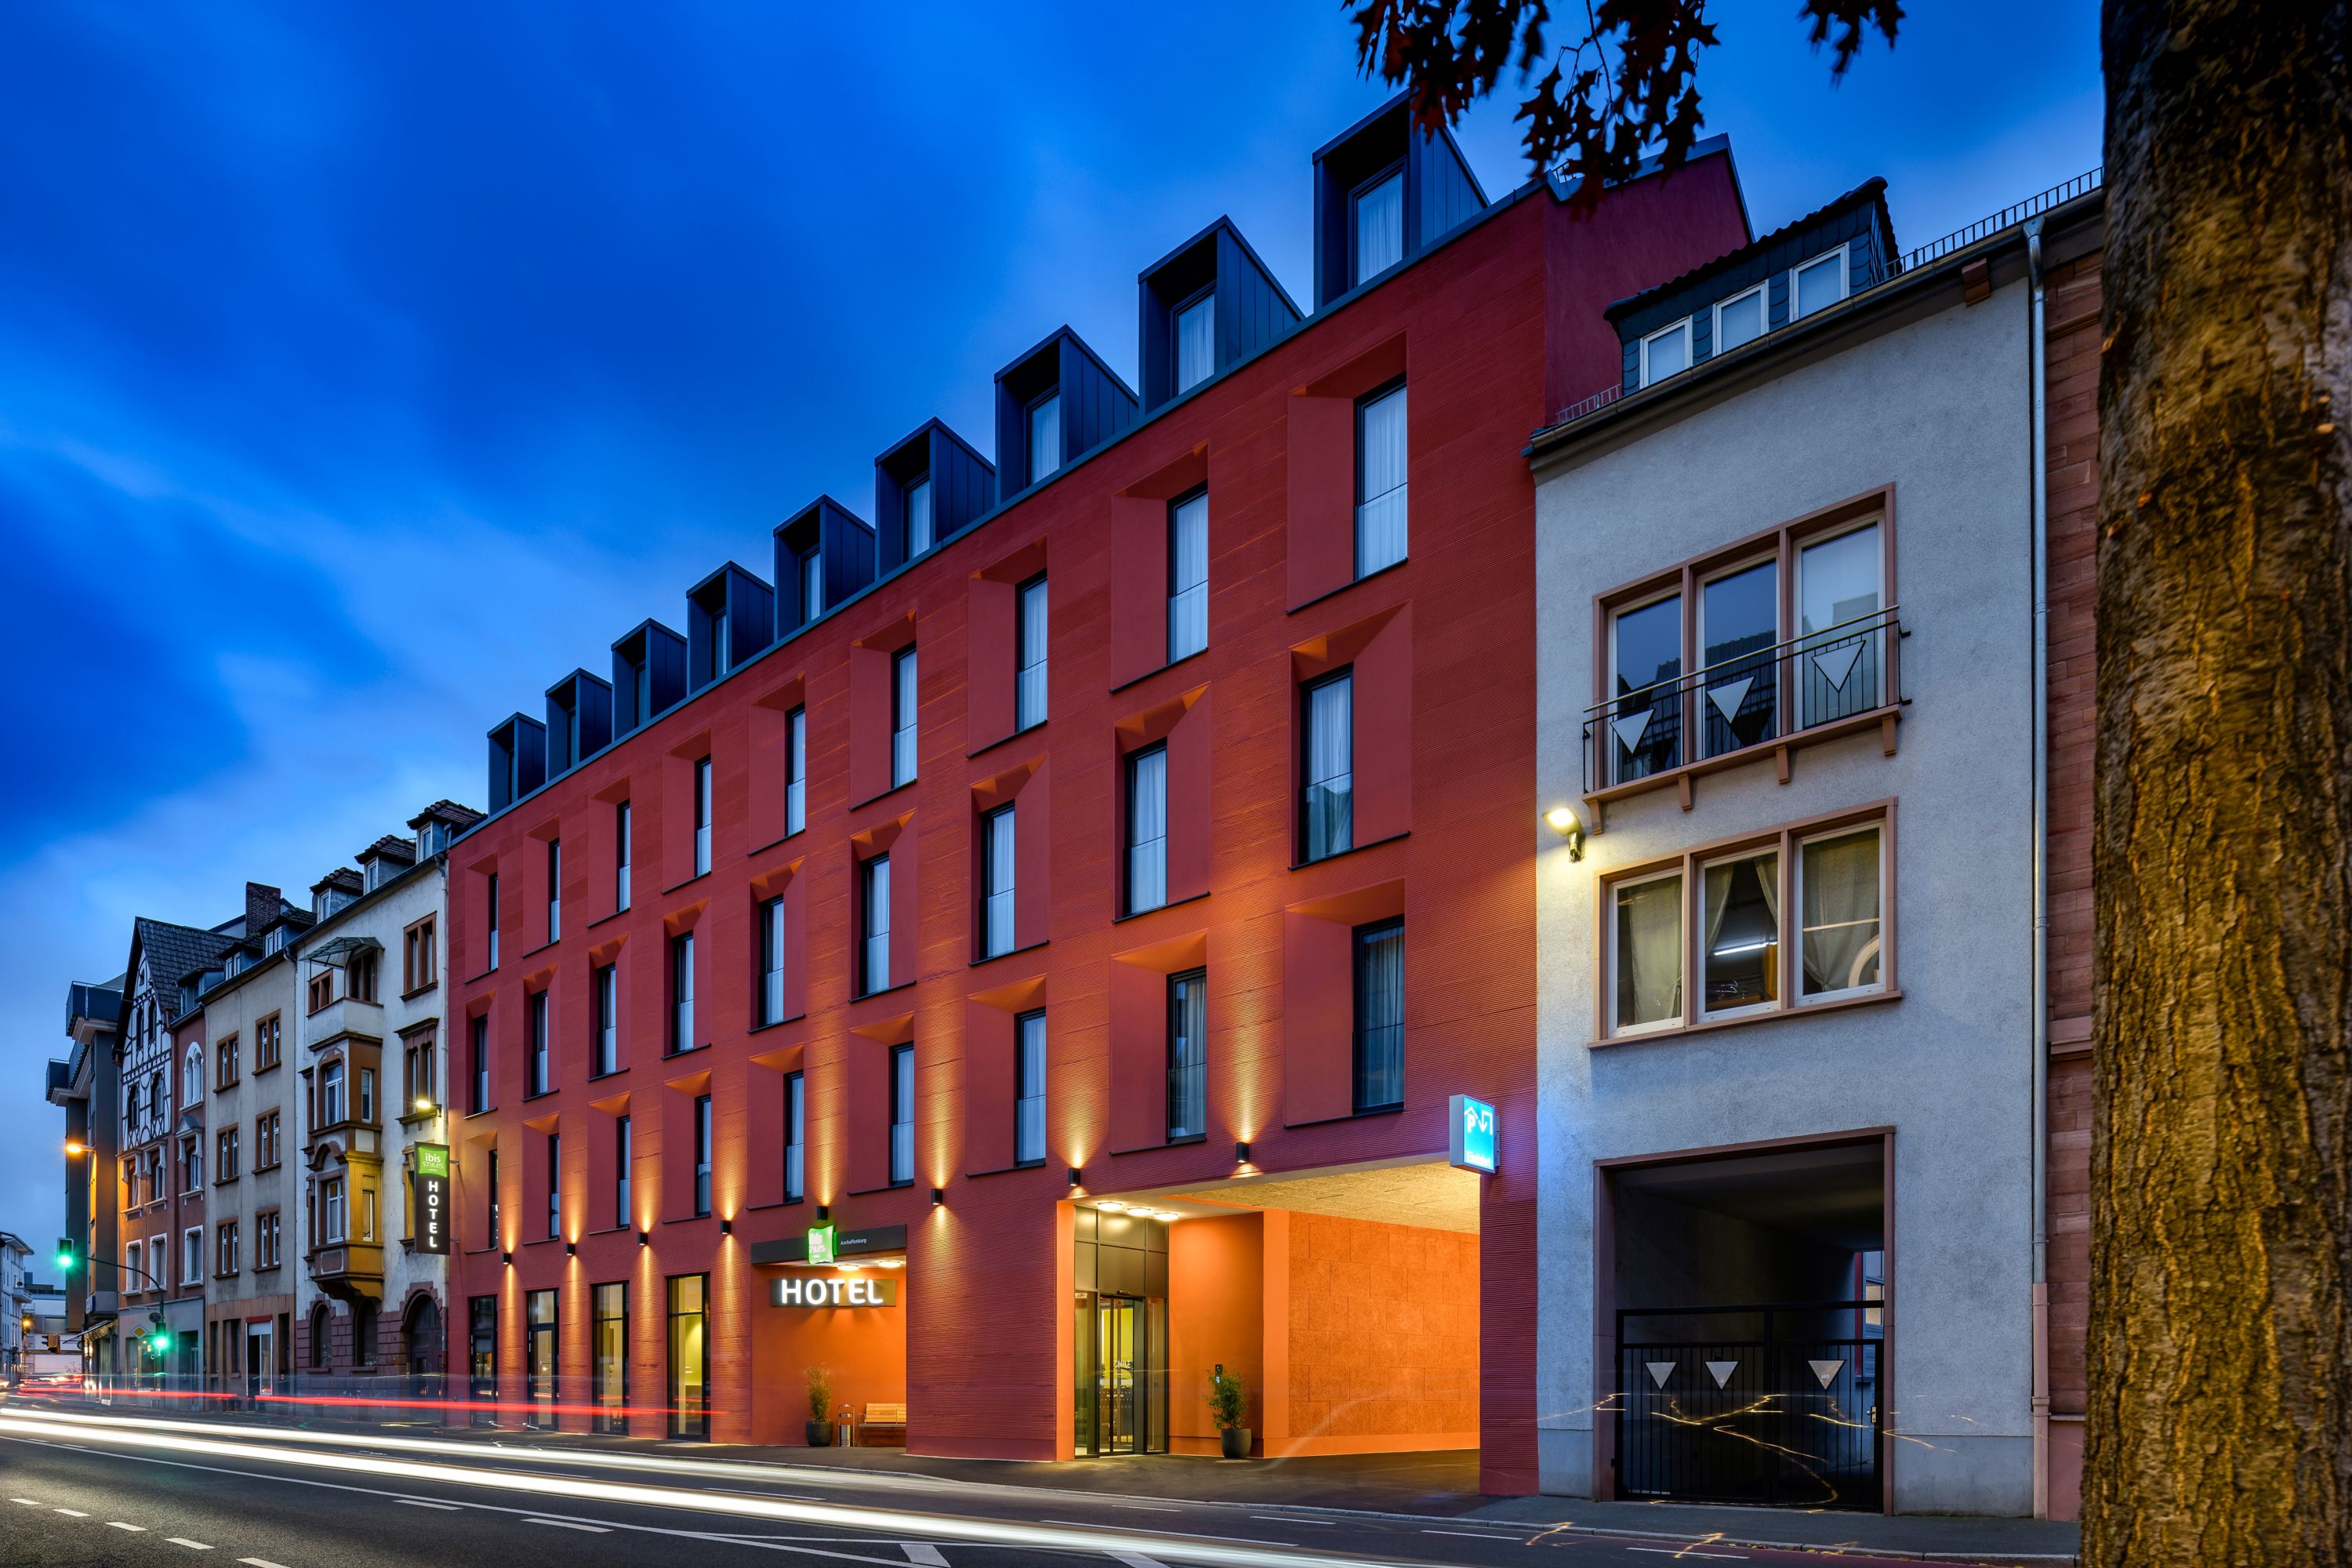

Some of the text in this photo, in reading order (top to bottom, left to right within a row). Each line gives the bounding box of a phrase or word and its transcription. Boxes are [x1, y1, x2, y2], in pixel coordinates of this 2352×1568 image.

[425, 1152, 441, 1163] ibis
[428, 1180, 439, 1248] HOTEL
[781, 1278, 884, 1305] HOTEL
[1115, 1360, 1131, 1369] SMILE
